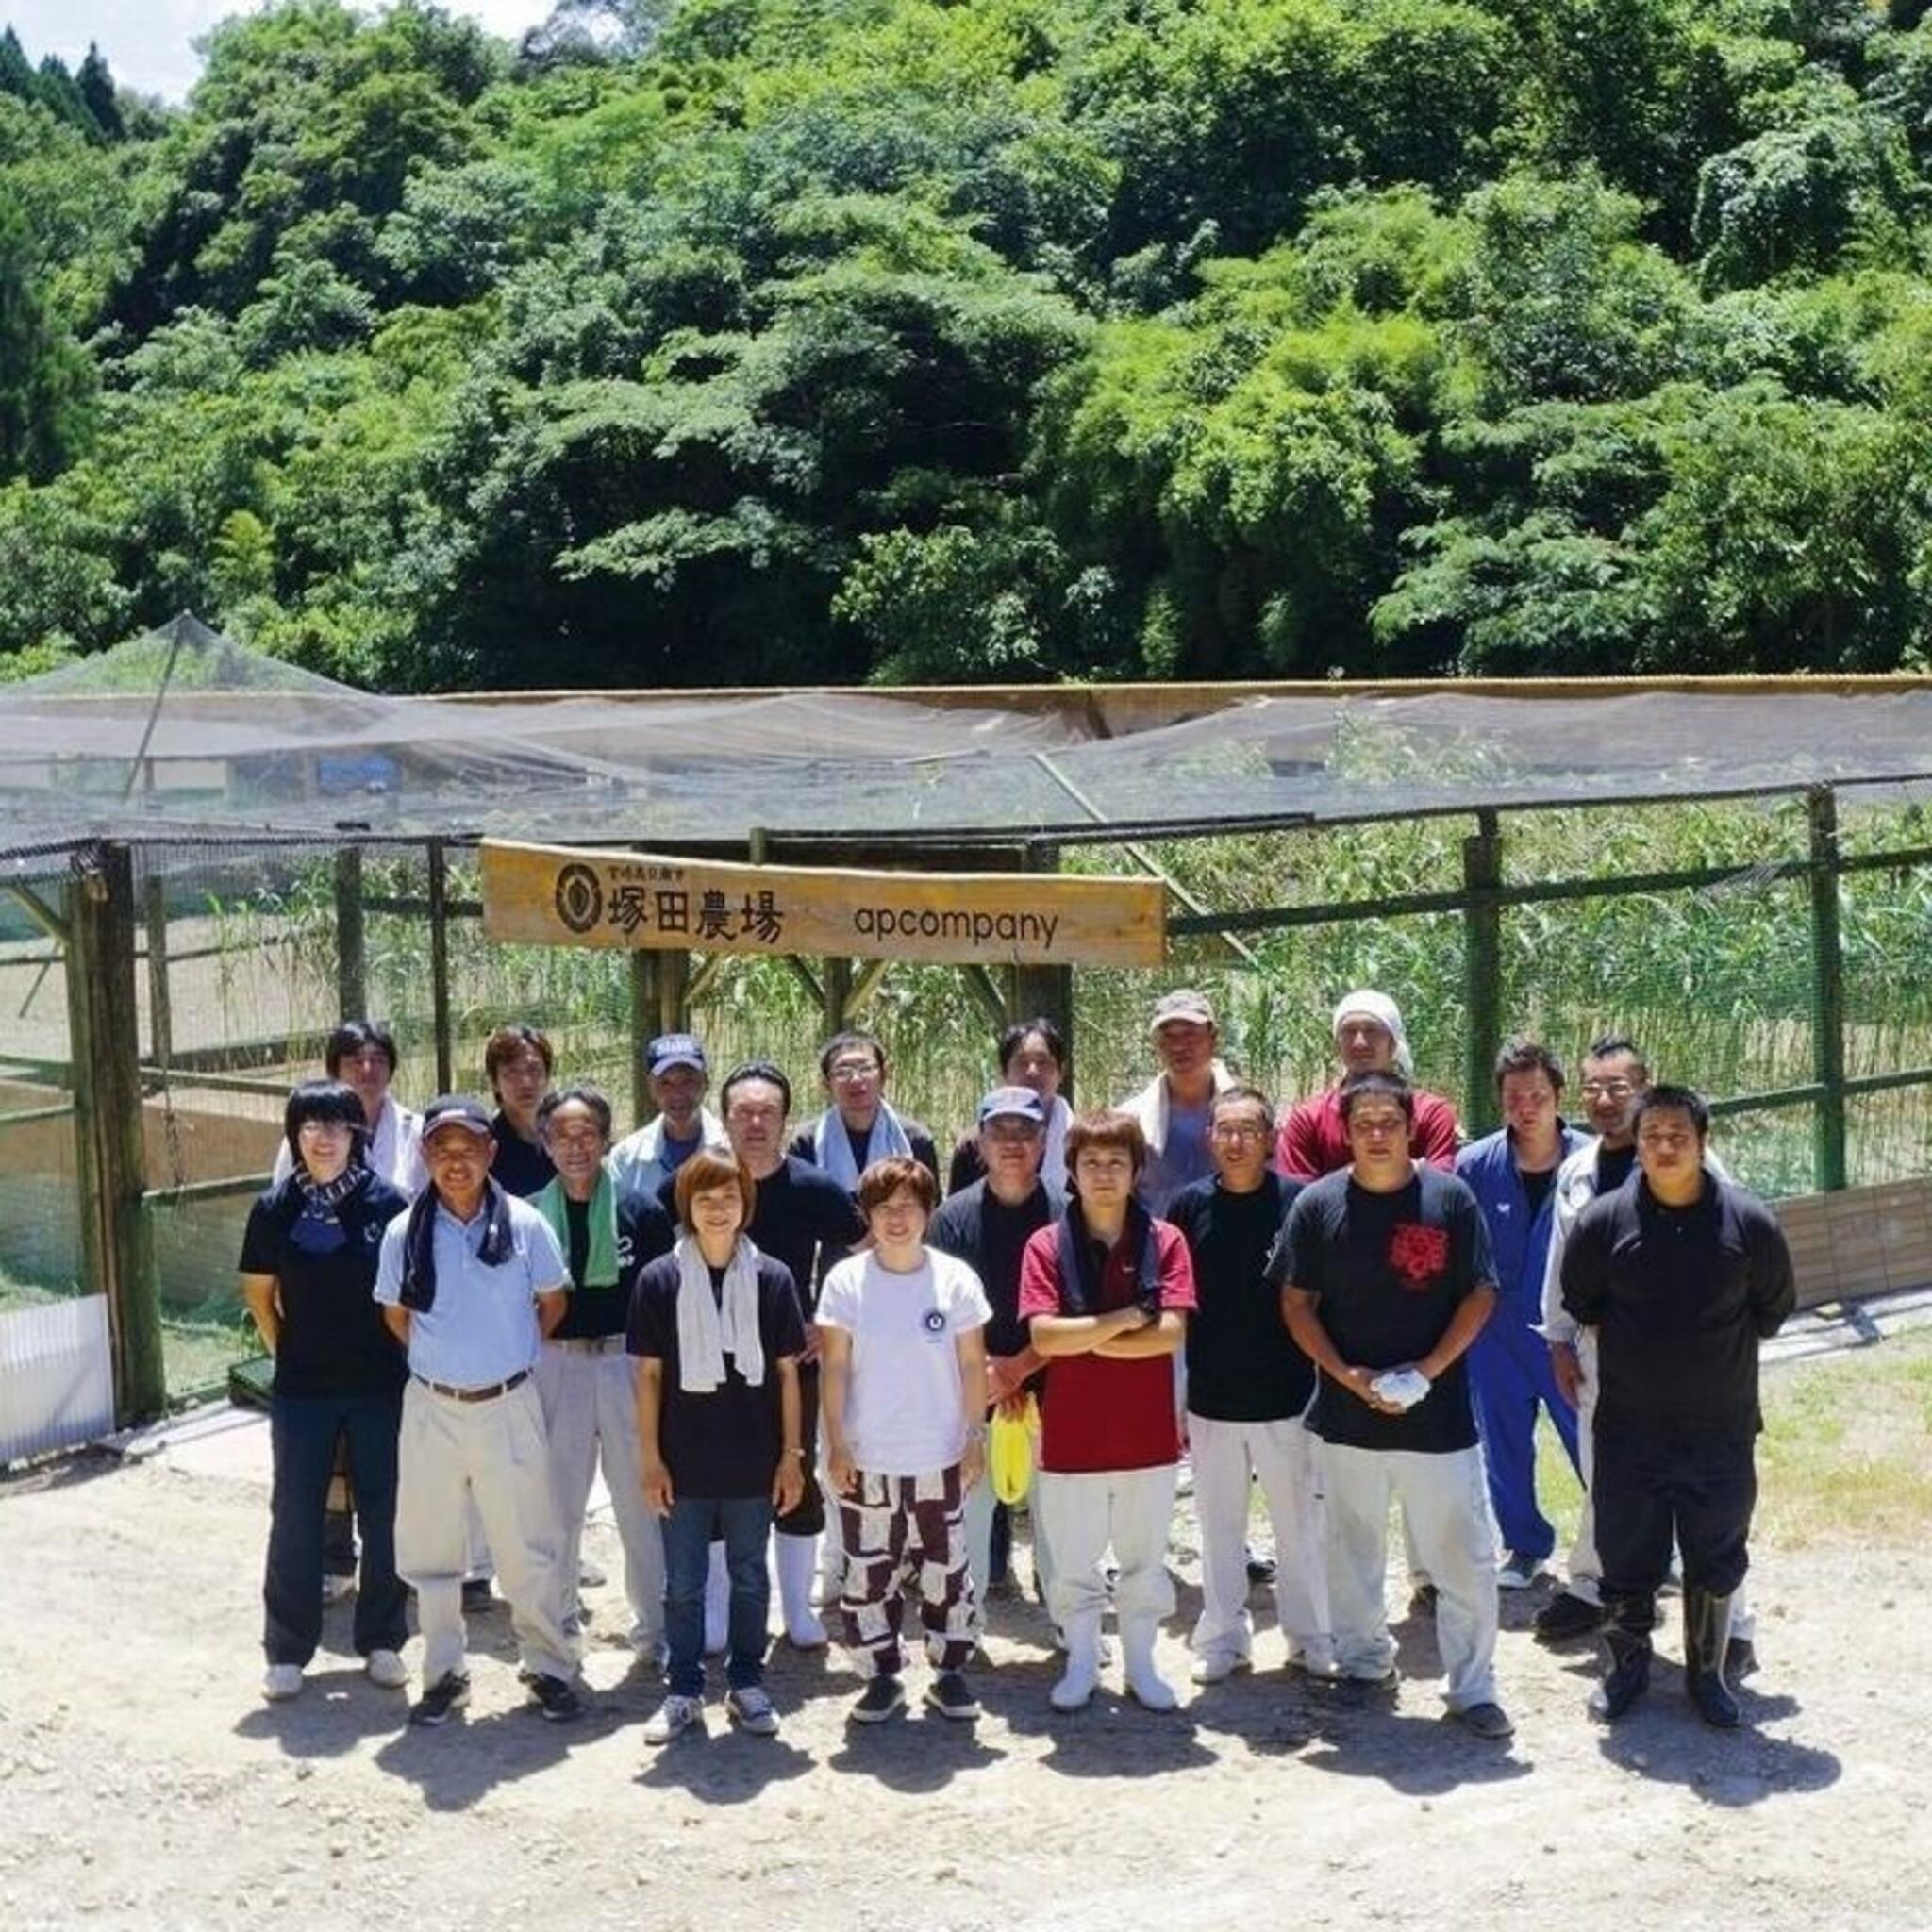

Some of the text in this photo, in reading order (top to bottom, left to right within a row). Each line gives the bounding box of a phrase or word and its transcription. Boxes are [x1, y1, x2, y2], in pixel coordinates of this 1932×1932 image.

[608, 884, 783, 944] 塚田農場
[855, 908, 1059, 949] apcompany
